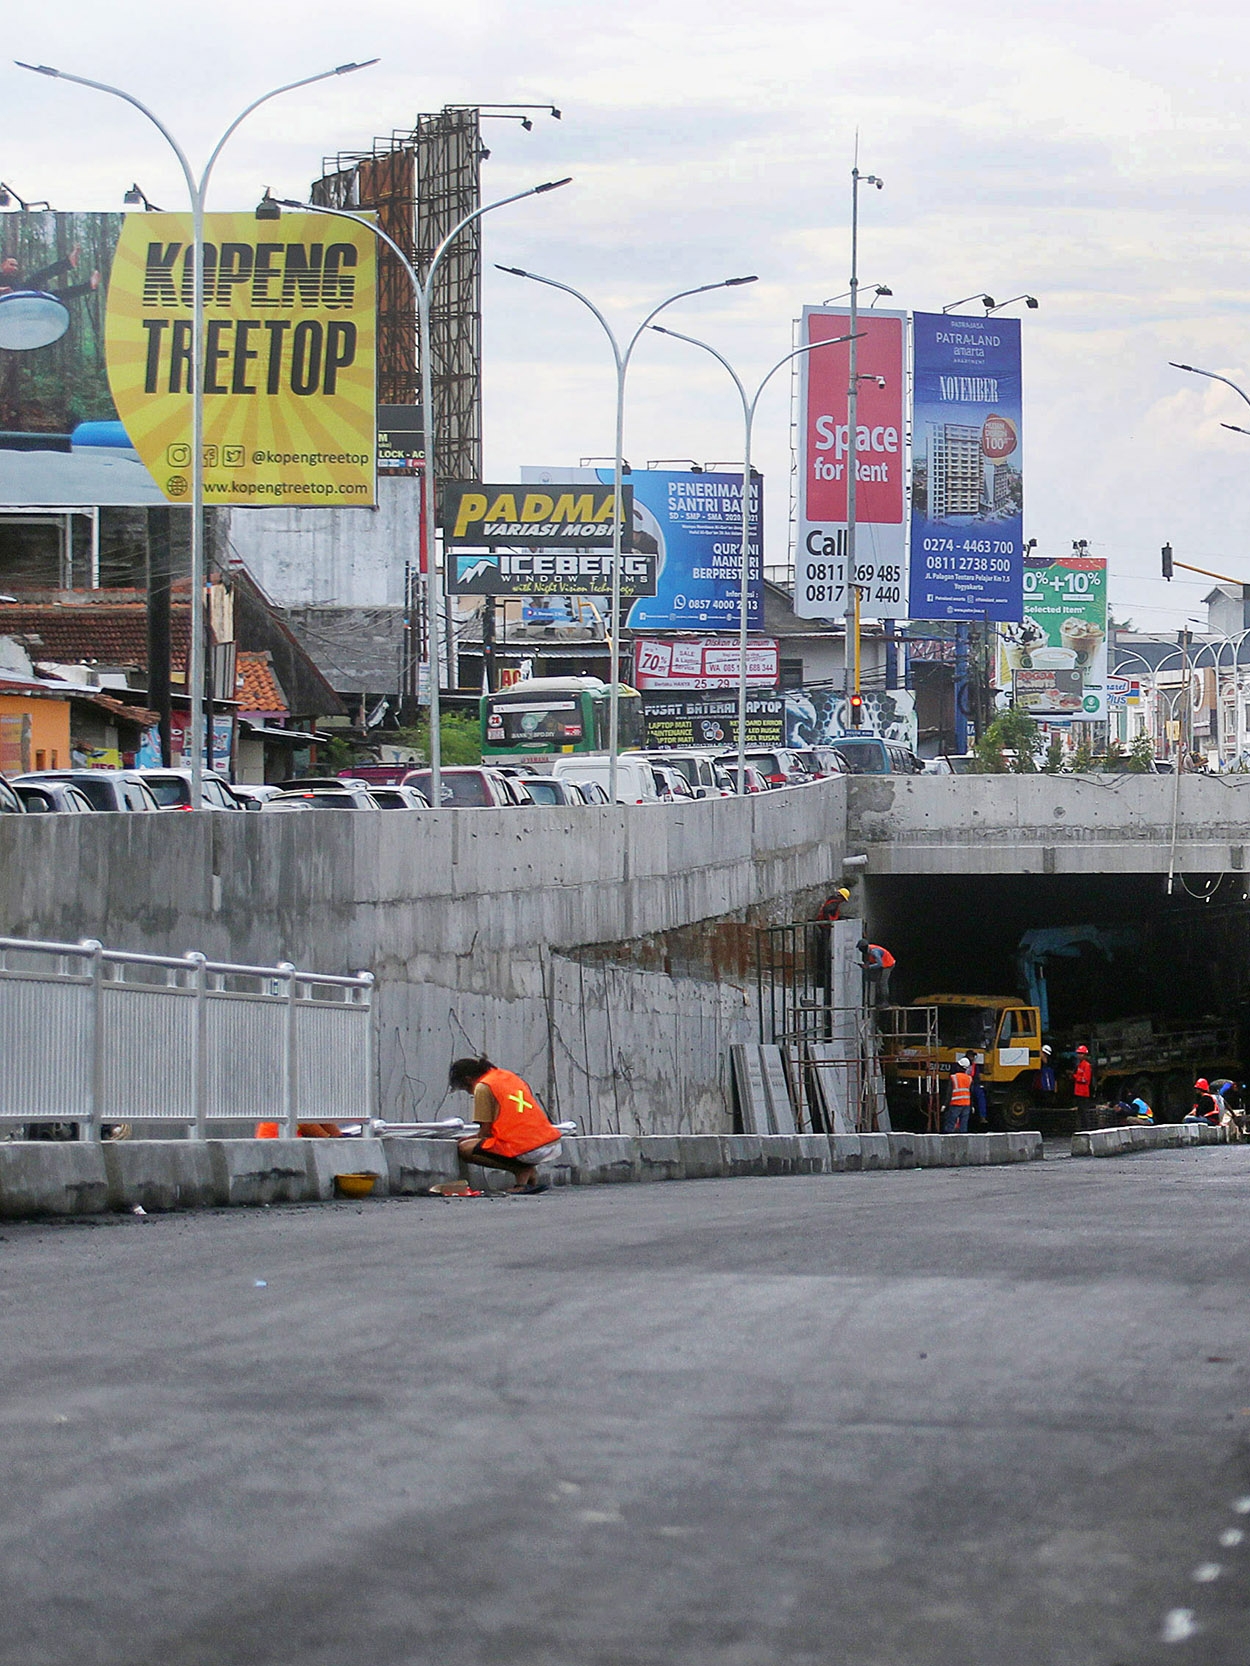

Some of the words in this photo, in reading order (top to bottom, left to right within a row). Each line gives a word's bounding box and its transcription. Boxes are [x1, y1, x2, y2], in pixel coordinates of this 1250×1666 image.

[142, 242, 359, 310] KOPENG
[142, 319, 358, 396] TREETOP
[939, 375, 999, 402] NOVEMBER
[815, 415, 898, 460] Space
[252, 451, 369, 467] @kopengtreetop
[379, 450, 405, 458] LOCK
[412, 450, 425, 459] AC
[814, 457, 844, 481] for
[668, 482, 759, 498] PENERIMAAN
[668, 497, 718, 512] SANTRI
[722, 499, 758, 513] BAU
[453, 493, 626, 537] PADMA
[669, 512, 679, 520] SD
[686, 512, 700, 520] SMP
[707, 513, 723, 521] SMA
[483, 523, 556, 536] VARIASI
[806, 530, 848, 556] Call
[923, 538, 954, 552] 0274
[963, 540, 991, 553] 4463
[993, 541, 1014, 554] 700
[500, 556, 648, 575] ICEBERG
[712, 556, 759, 567] MANDRI
[926, 556, 956, 570] 0811
[959, 557, 988, 571] 2738
[989, 558, 1011, 571] 500
[501, 575, 578, 583] WINDOW
[592, 575, 648, 583] FIMS
[806, 563, 844, 581] 0811
[877, 565, 901, 582] 485
[534, 583, 557, 594] Night
[560, 583, 588, 593] Vision
[806, 585, 844, 602] 0817
[875, 586, 900, 603] 440
[688, 600, 710, 609] 0857
[713, 600, 735, 609] 4000
[737, 601, 758, 610] 213
[1024, 605, 1062, 614] Selected
[709, 664, 721, 672] WA
[695, 679, 708, 689] 25
[717, 679, 730, 688] 29
[644, 703, 684, 716] PUSAT
[686, 702, 736, 715] BATERAI
[746, 700, 783, 713] APTOP
[648, 721, 674, 729] LAPTOP
